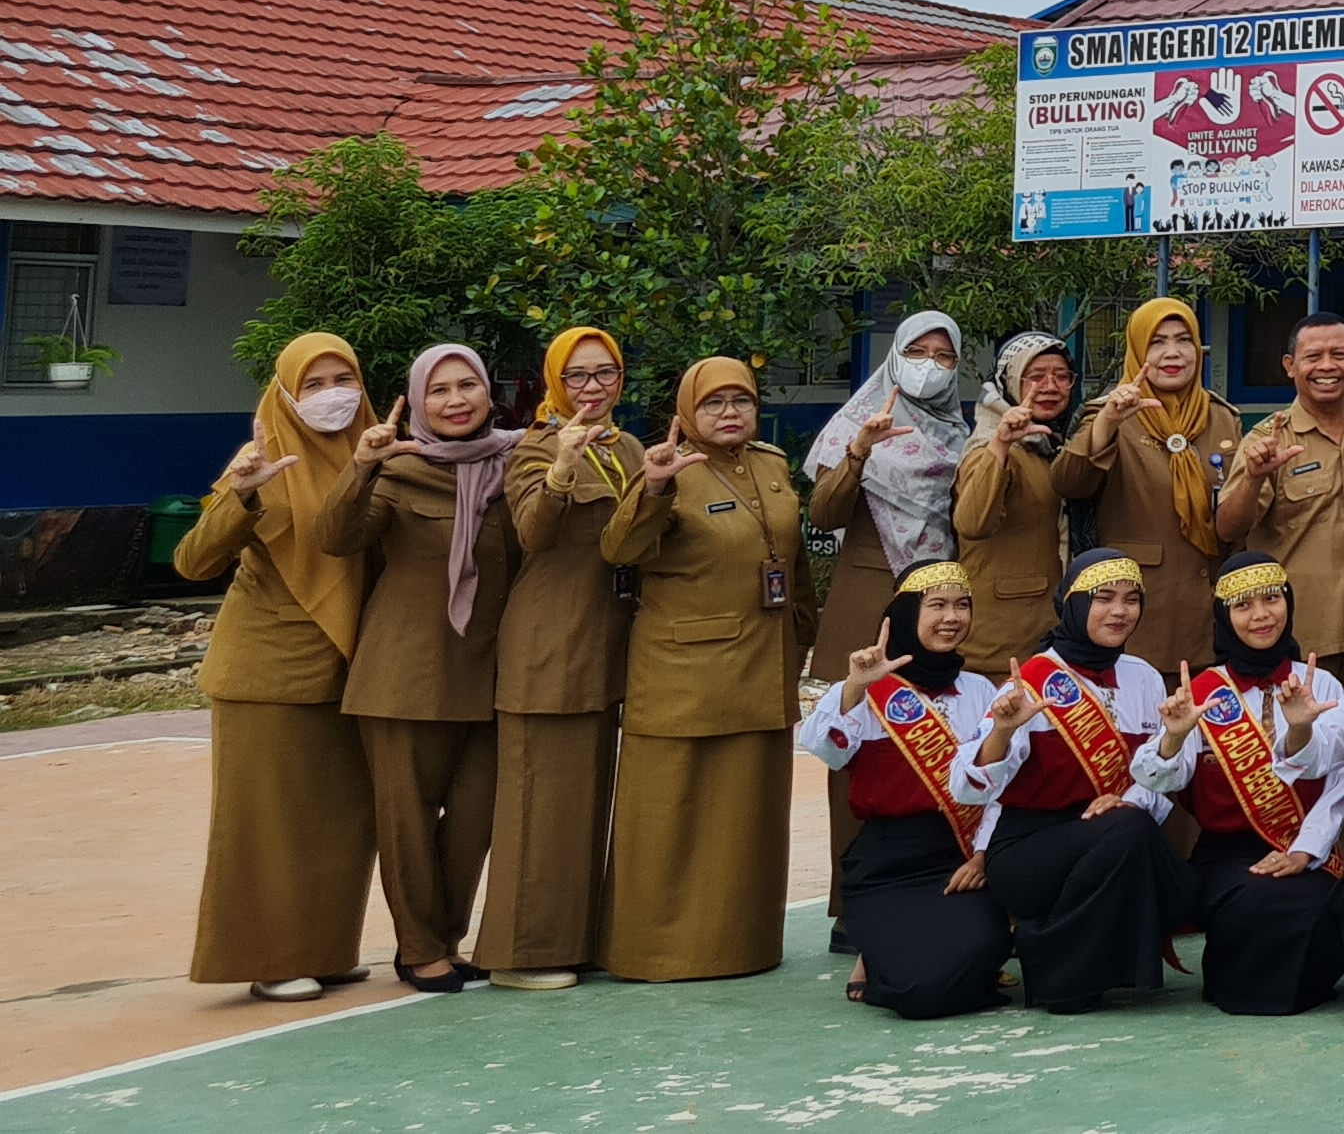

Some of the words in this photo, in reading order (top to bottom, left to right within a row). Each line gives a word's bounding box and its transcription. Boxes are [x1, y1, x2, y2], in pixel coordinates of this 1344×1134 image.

[1070, 34, 1123, 66] SMA
[1129, 27, 1216, 62] NEGERI
[1222, 24, 1249, 56] 12
[1029, 94, 1056, 104] STOP
[1059, 87, 1146, 102] PERUNDUNGAN!
[1028, 100, 1145, 129] (BULLYING)
[1187, 130, 1215, 140] UNITE
[1217, 128, 1259, 139] AGAINST
[1188, 138, 1258, 155] BULLYING
[1182, 182, 1206, 196] STOP
[904, 718, 955, 768] GADIS
[1062, 697, 1107, 751] WAKIL
[1089, 738, 1128, 788] GADIS
[1218, 721, 1267, 773] GADIS
[1241, 761, 1299, 835] BERBAKAT
